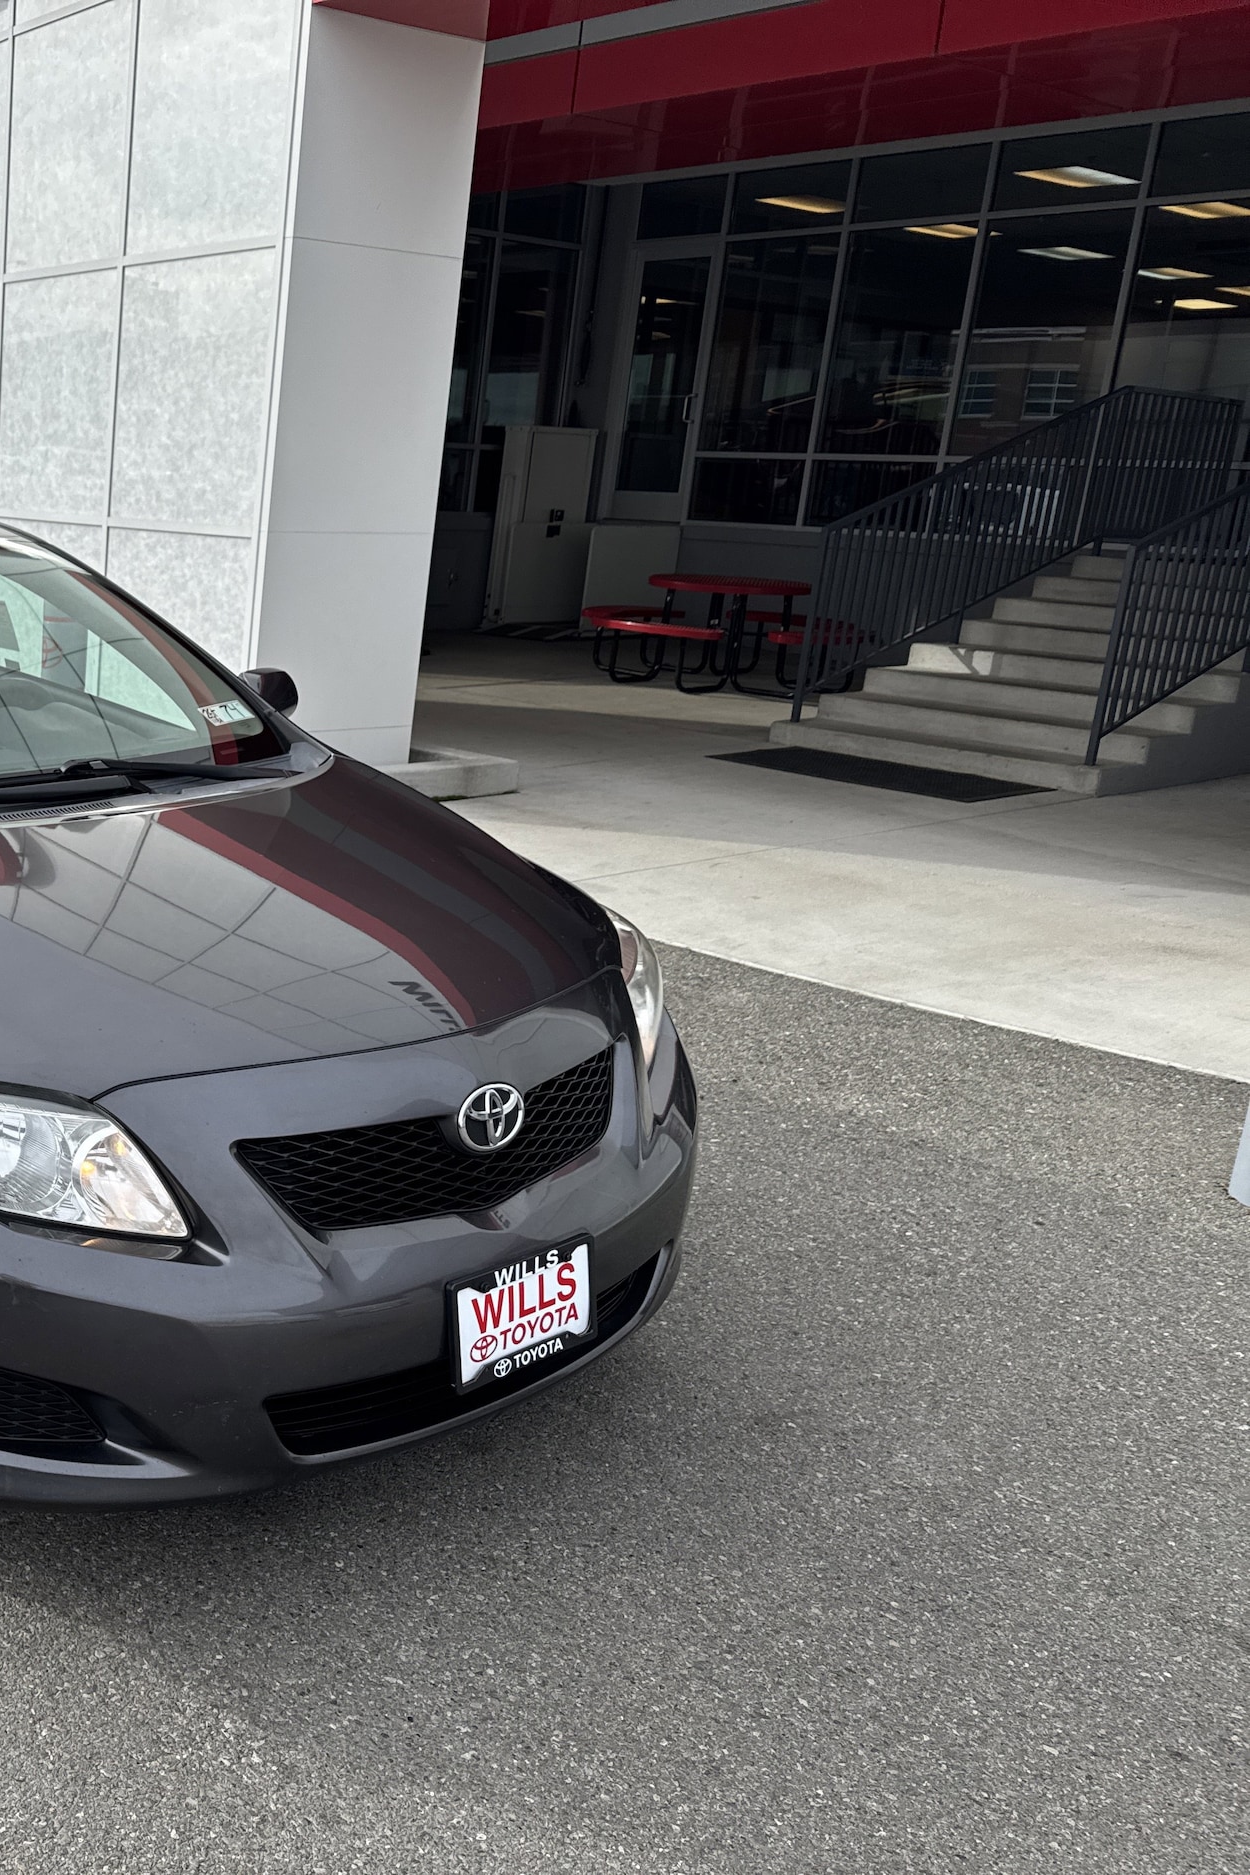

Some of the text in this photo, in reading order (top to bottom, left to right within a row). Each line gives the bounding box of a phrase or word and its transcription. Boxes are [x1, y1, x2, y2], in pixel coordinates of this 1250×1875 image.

[494, 1249, 559, 1287] WILLS
[471, 1262, 577, 1334] WILLS
[500, 1302, 579, 1350] TOYOTA
[513, 1337, 564, 1368] TOYOTA
